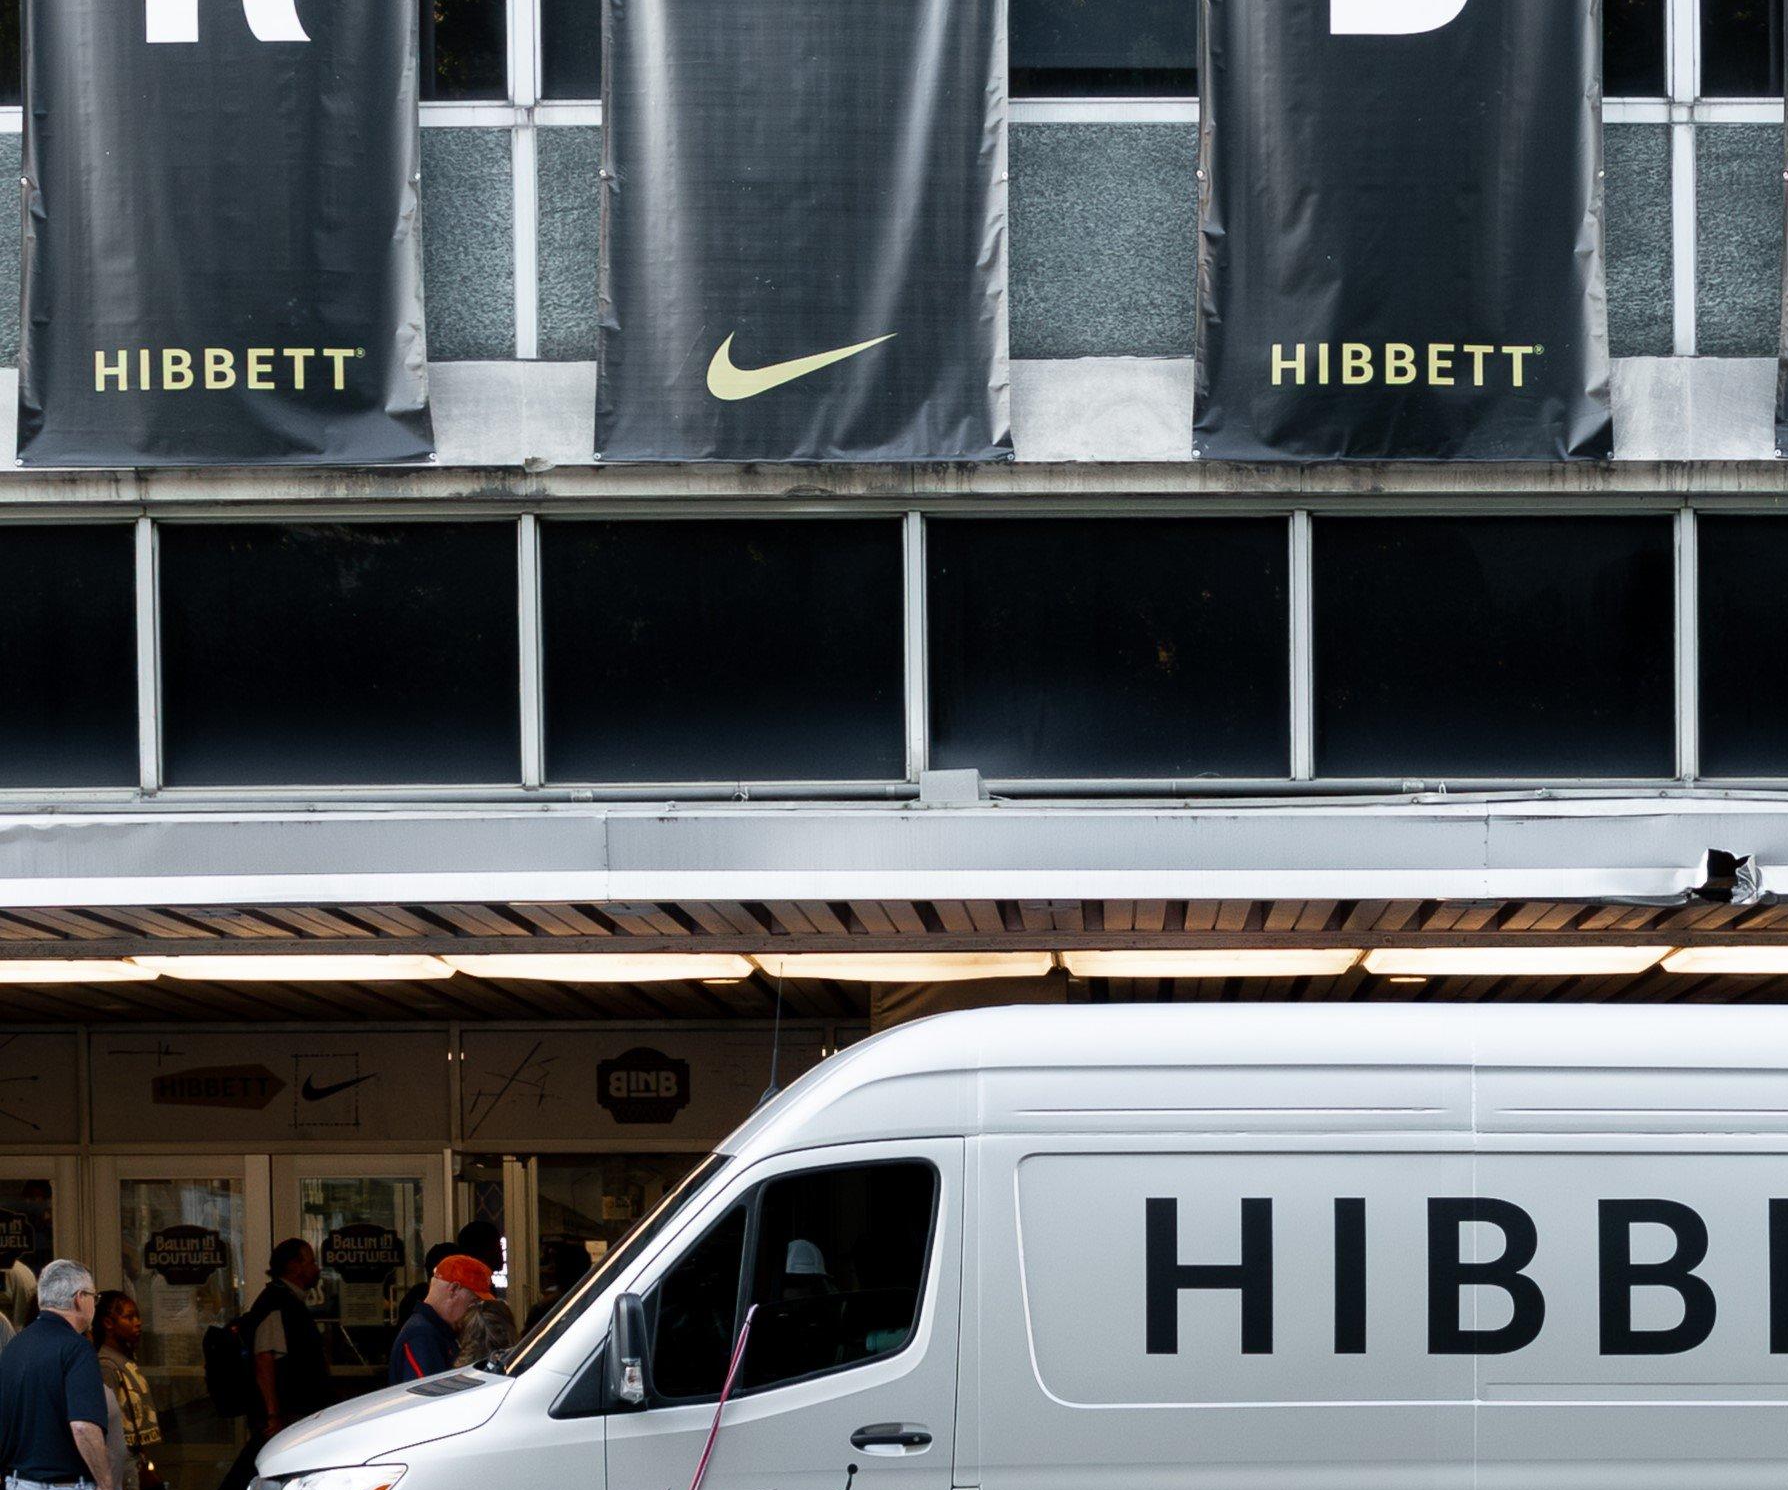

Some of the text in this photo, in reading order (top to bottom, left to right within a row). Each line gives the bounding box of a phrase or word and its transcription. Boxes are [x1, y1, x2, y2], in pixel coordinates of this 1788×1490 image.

[159, 1075, 270, 1098] HIBBETT
[148, 1251, 224, 1265] BOUTWELL
[326, 1250, 400, 1264] BOUTWELL
